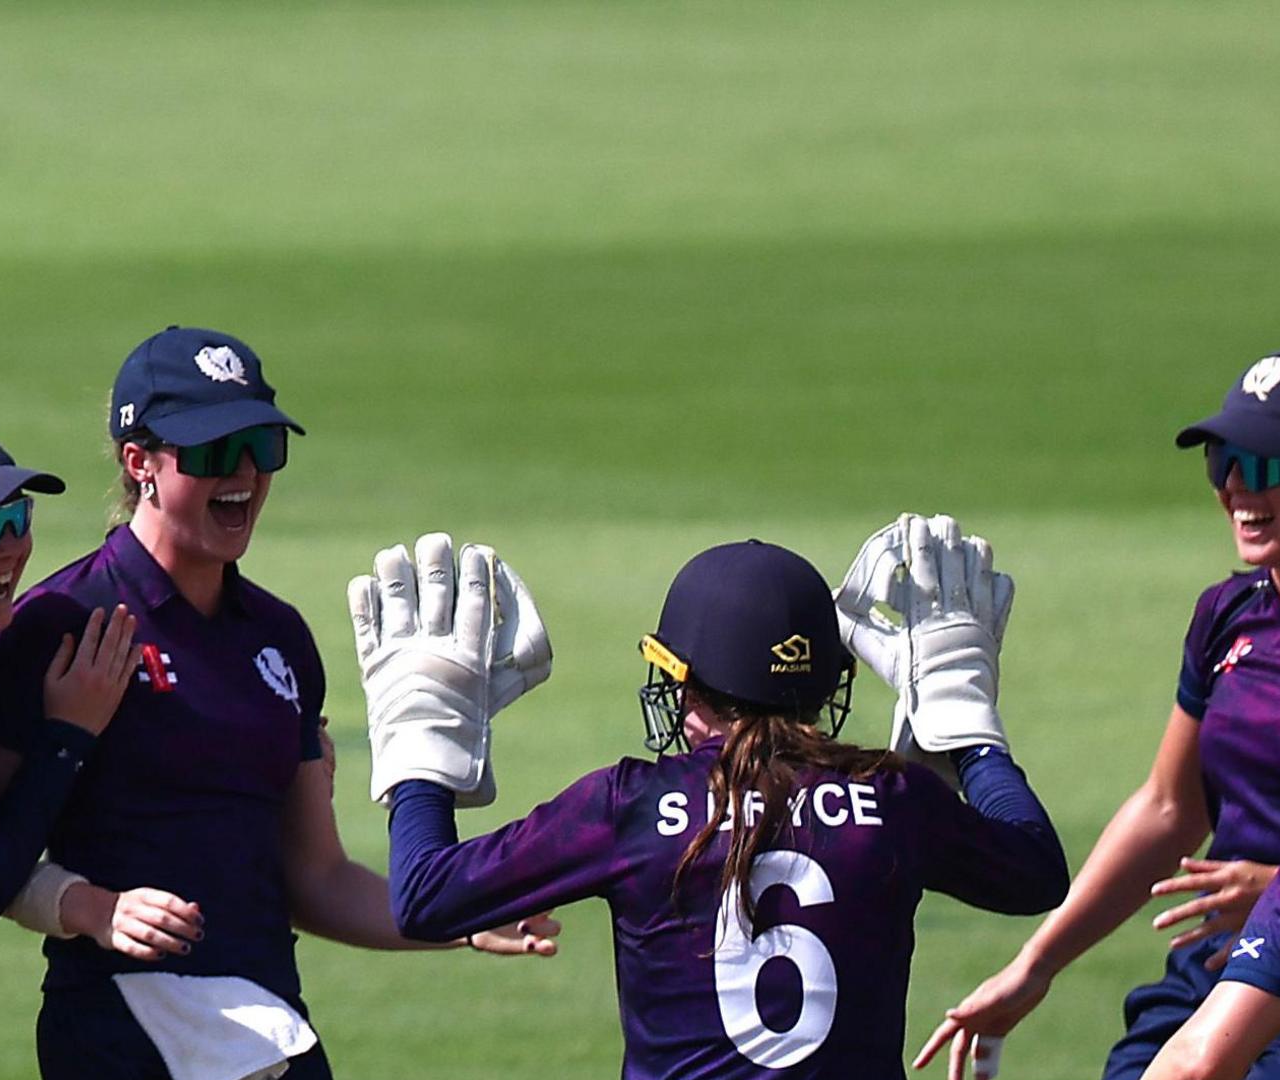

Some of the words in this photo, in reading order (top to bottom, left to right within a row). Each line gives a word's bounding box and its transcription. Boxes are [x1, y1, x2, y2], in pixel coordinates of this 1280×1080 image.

[119, 403, 135, 428] 73
[656, 791, 689, 836] S
[714, 850, 838, 1069] 6
